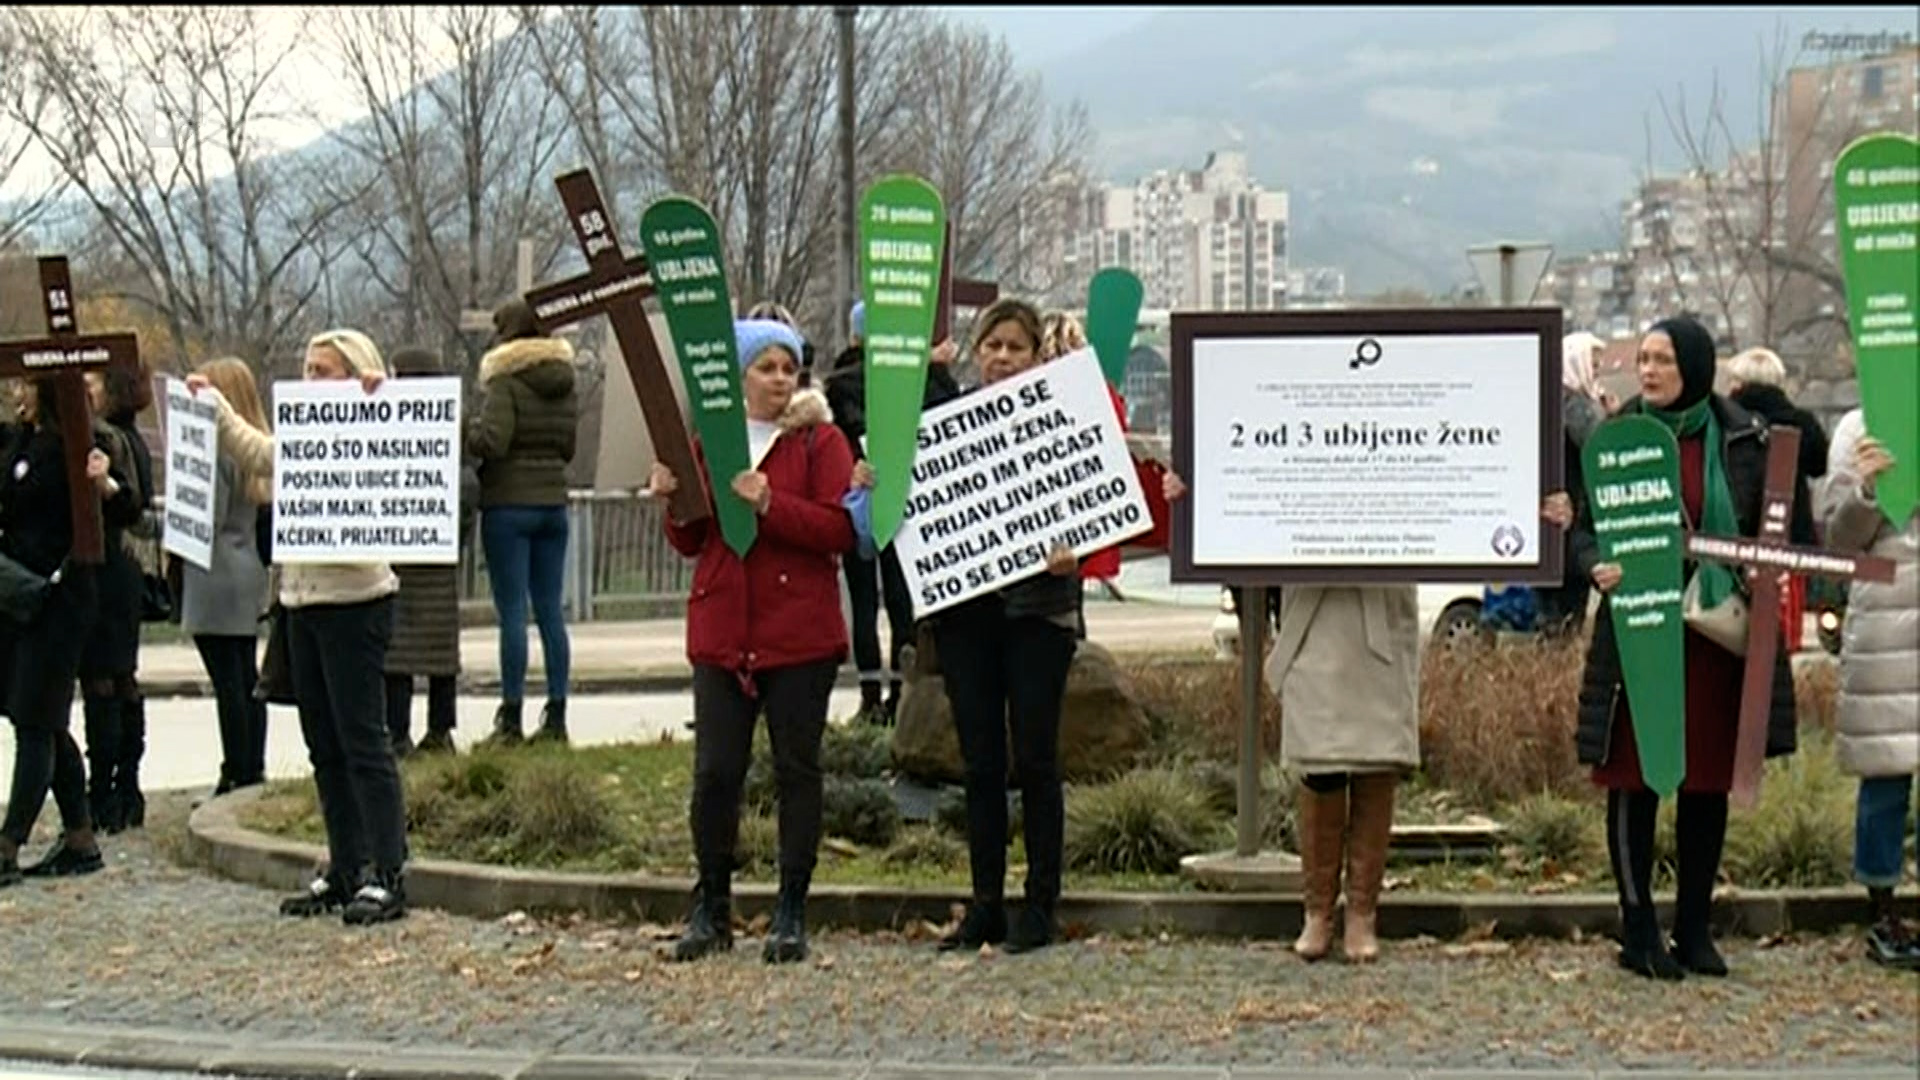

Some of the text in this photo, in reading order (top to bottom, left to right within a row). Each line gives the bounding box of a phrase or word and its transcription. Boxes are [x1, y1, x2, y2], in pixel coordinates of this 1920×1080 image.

[890, 207, 934, 223] godina
[870, 240, 933, 261] UBIJENA
[656, 255, 719, 282] UBIJENA
[871, 268, 886, 284] od
[278, 400, 456, 425] REAGUJMO PRIJE
[917, 378, 1053, 450] SJETIMO SE
[282, 435, 450, 460] NEGO ŠTO NASILNICI
[1230, 420, 1501, 452] 2 od 3 ubijene žene
[911, 432, 1008, 484] UBIJENIH
[991, 459, 1019, 484] IM
[1023, 423, 1103, 471] POČAST
[1618, 446, 1663, 467] godina
[282, 464, 448, 489] POSTANU UBICE ŽENA,
[920, 454, 1103, 543] PRIJAVLJIVANJEM
[1596, 478, 1673, 508] UBIJENA
[278, 495, 452, 519] VAŠIH MAJKI, SESTARA,
[915, 477, 1126, 577] NASILJA PRIJE NEGO
[1739, 545, 1755, 560] od
[921, 576, 962, 606] ŠTO
[966, 562, 995, 588] SE
[997, 541, 1048, 576] DESI
